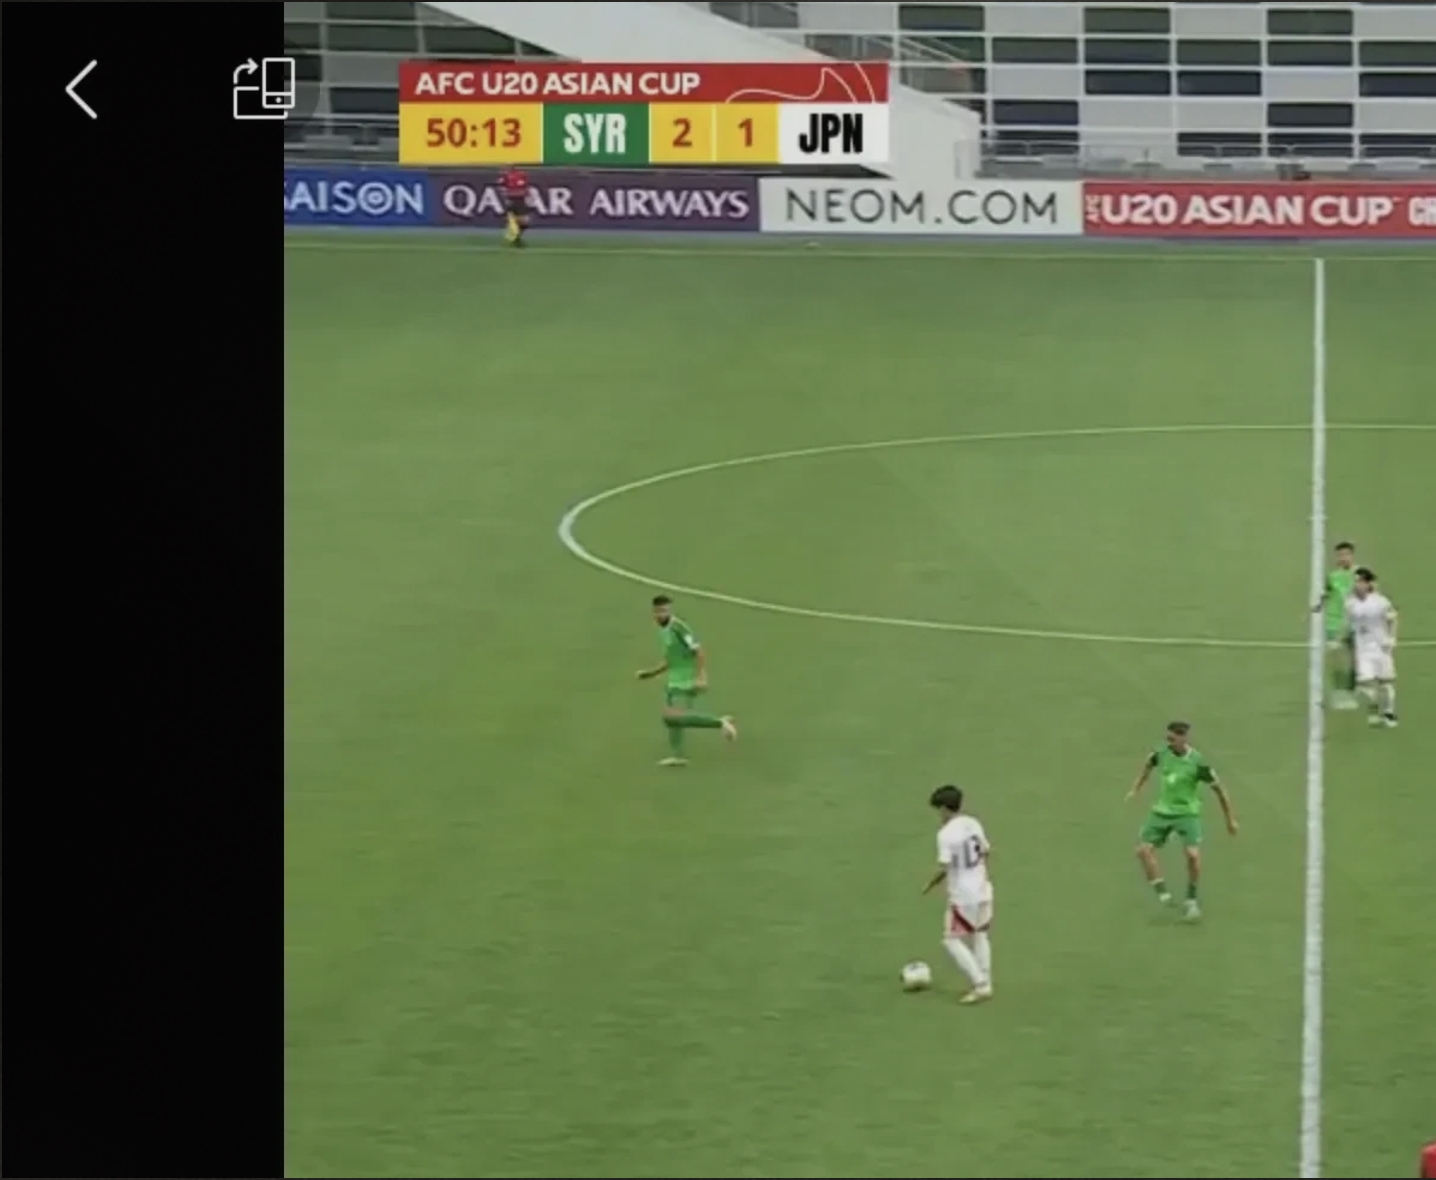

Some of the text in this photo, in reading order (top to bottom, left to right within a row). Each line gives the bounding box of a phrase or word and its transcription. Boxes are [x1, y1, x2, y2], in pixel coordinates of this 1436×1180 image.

[284, 180, 424, 215] AISON
[443, 184, 750, 219] QAAR AIRWAYS
[785, 188, 1058, 225] NEOM.COM
[1101, 193, 1177, 226] U20
[1181, 194, 1304, 226] ASIAN
